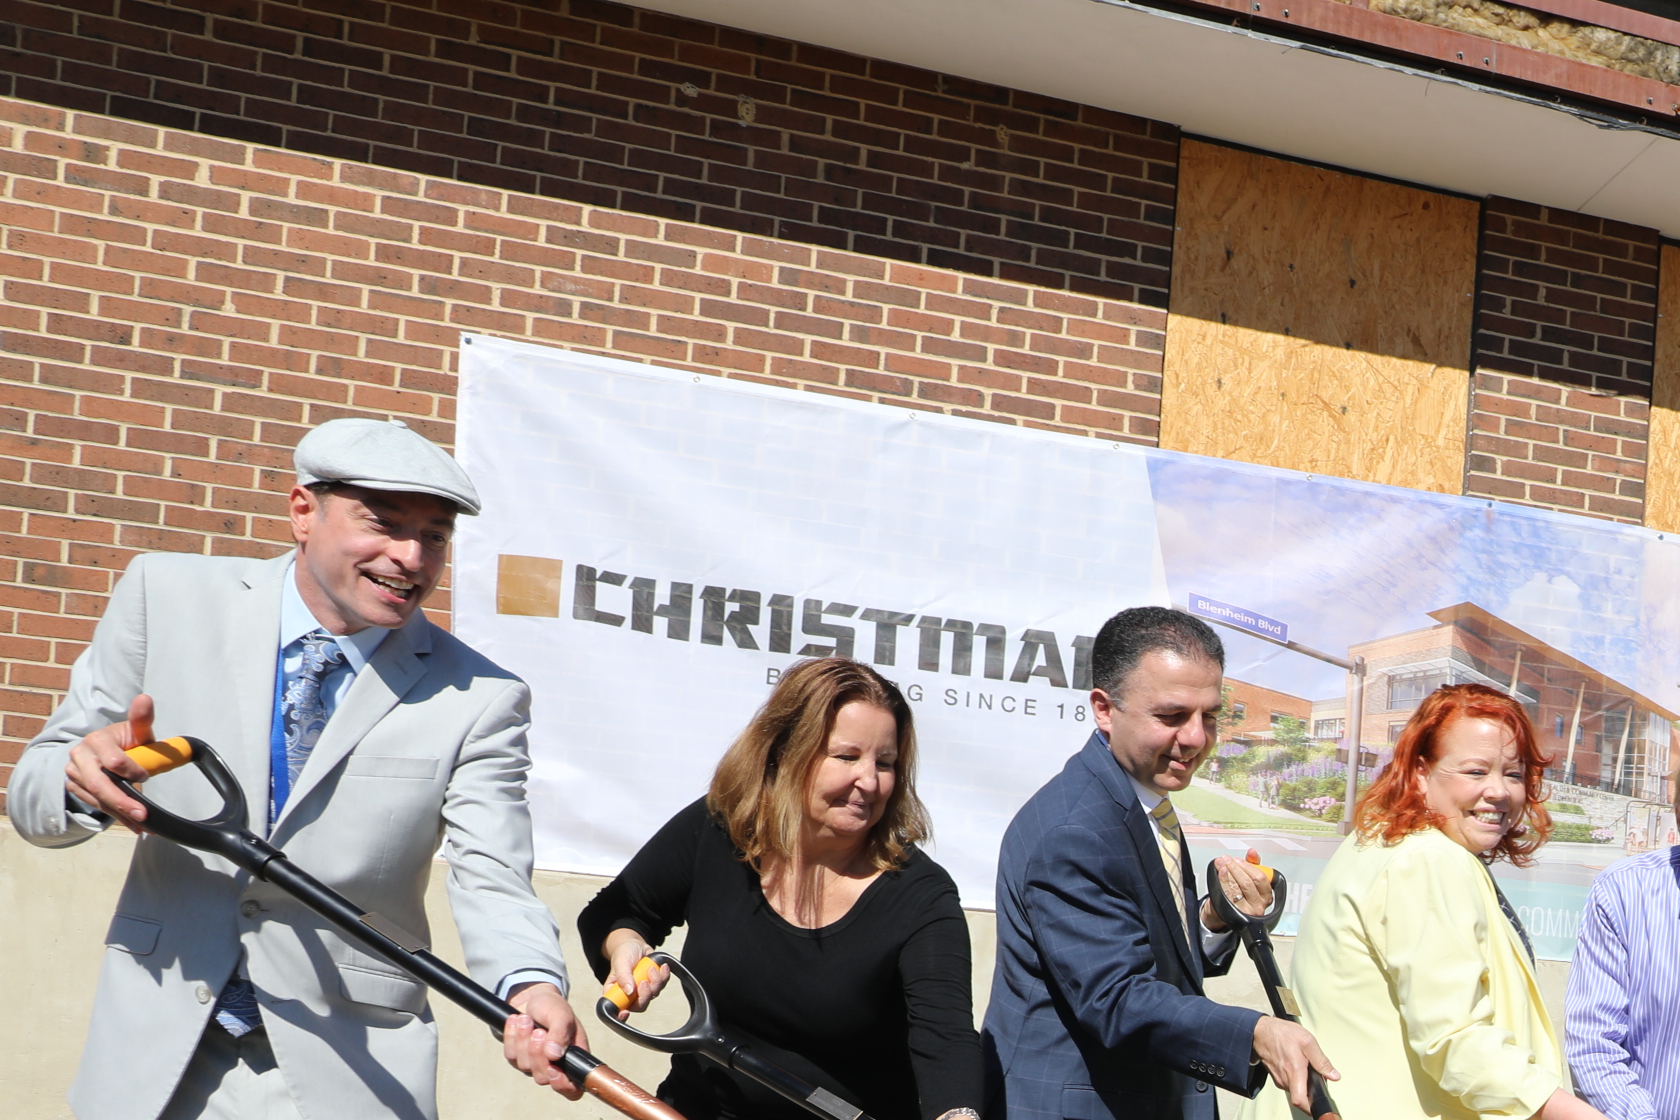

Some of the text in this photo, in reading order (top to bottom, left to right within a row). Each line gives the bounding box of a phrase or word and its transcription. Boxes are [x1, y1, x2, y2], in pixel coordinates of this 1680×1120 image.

[1197, 600, 1281, 635] Blenheim Blvd
[944, 688, 1087, 722] SINCE 18
